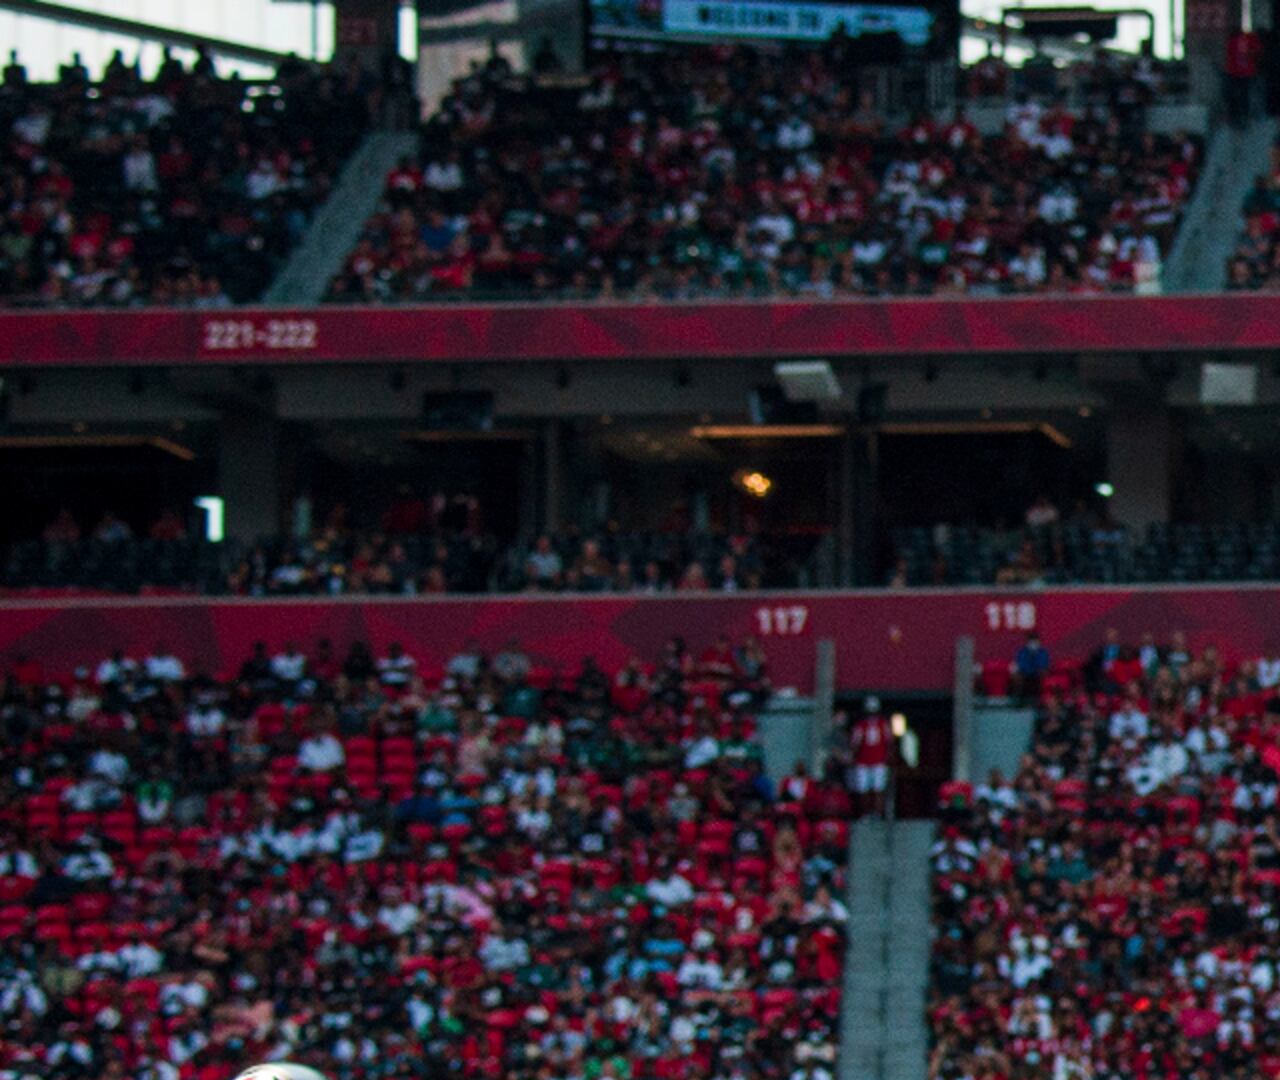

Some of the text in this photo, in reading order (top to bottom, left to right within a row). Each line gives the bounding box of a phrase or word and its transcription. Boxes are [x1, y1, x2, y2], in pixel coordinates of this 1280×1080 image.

[205, 320, 318, 348] 221-222
[757, 605, 808, 635] 117
[985, 602, 1035, 630] 118
